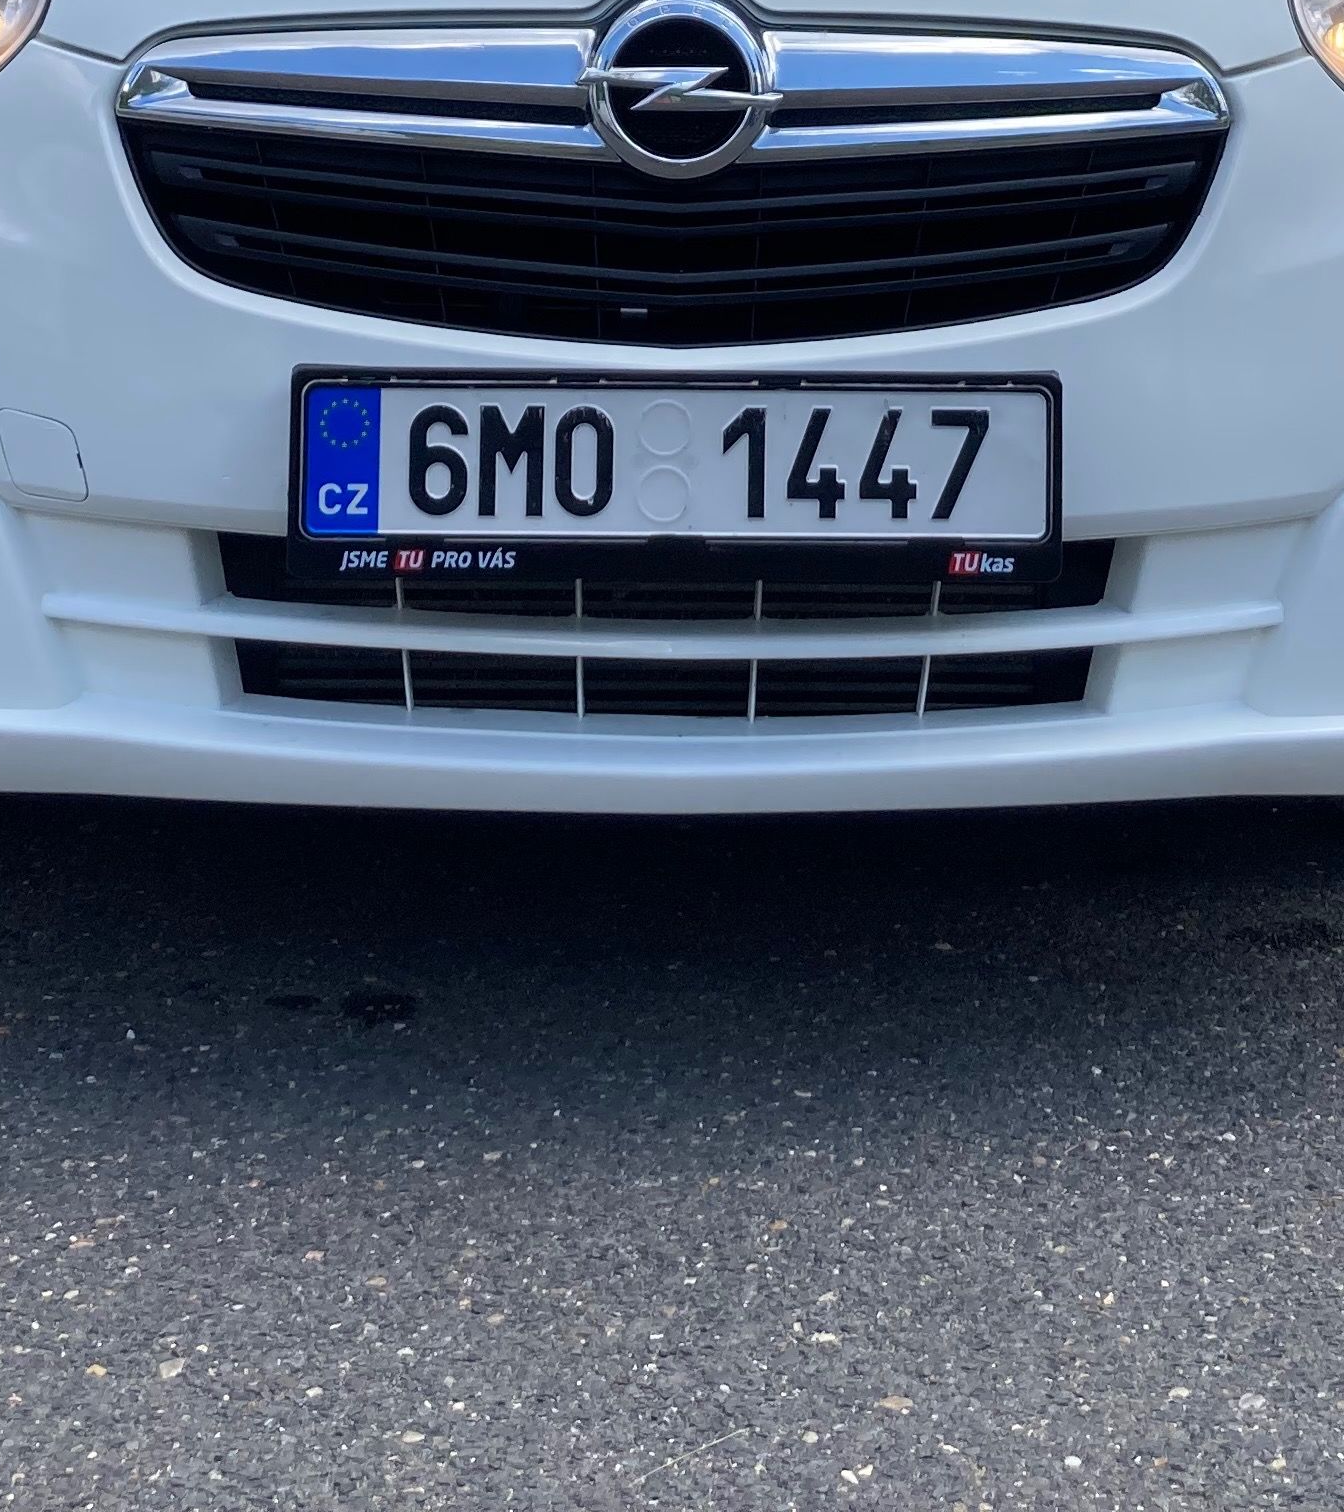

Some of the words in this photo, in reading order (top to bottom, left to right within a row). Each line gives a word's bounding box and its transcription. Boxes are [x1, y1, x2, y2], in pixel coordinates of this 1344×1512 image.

[627, 4, 731, 31] OPEL
[408, 404, 615, 518] 6M0
[722, 406, 990, 520] 1447
[318, 482, 369, 515] CZ
[339, 550, 389, 571] JSME
[399, 550, 424, 569] TU
[431, 550, 472, 569] PRO
[477, 547, 517, 569] VÁS
[953, 552, 1015, 573] TUkas
